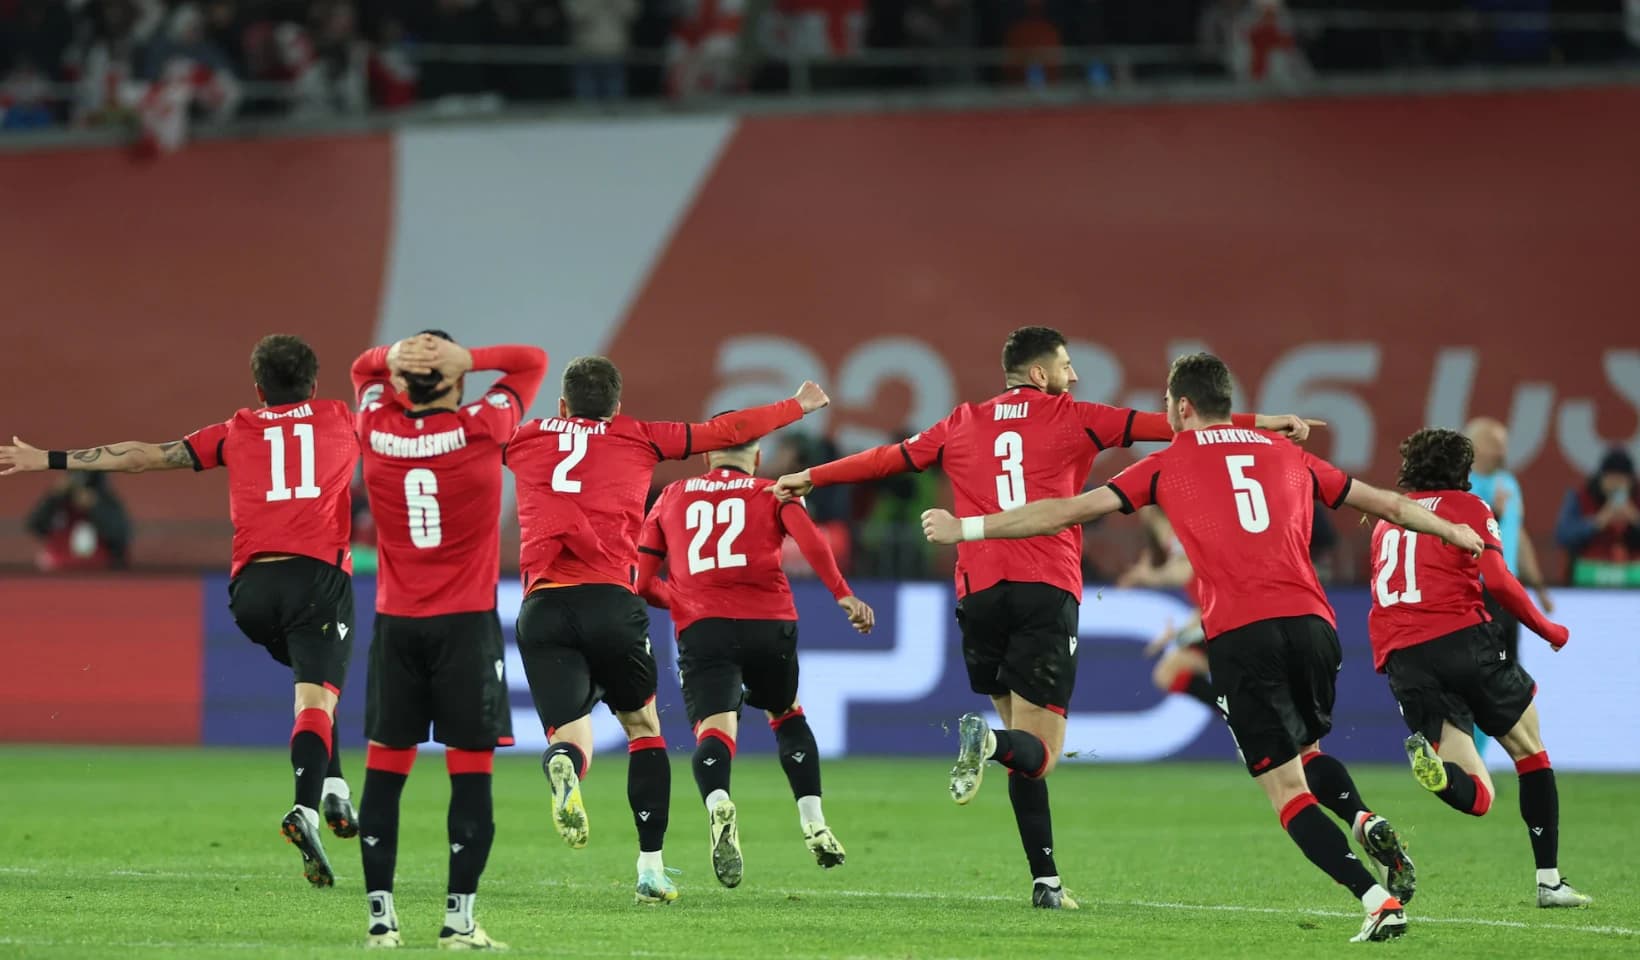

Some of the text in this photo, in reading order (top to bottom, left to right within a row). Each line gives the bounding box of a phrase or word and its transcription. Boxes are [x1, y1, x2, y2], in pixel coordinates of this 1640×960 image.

[994, 402, 1029, 421] DVALI
[263, 424, 321, 502] 11
[551, 432, 588, 493] 2
[994, 431, 1027, 512] 3
[1225, 454, 1270, 534] 5
[404, 468, 442, 549] 6
[686, 498, 747, 576] 22
[1376, 529, 1421, 607] 21
